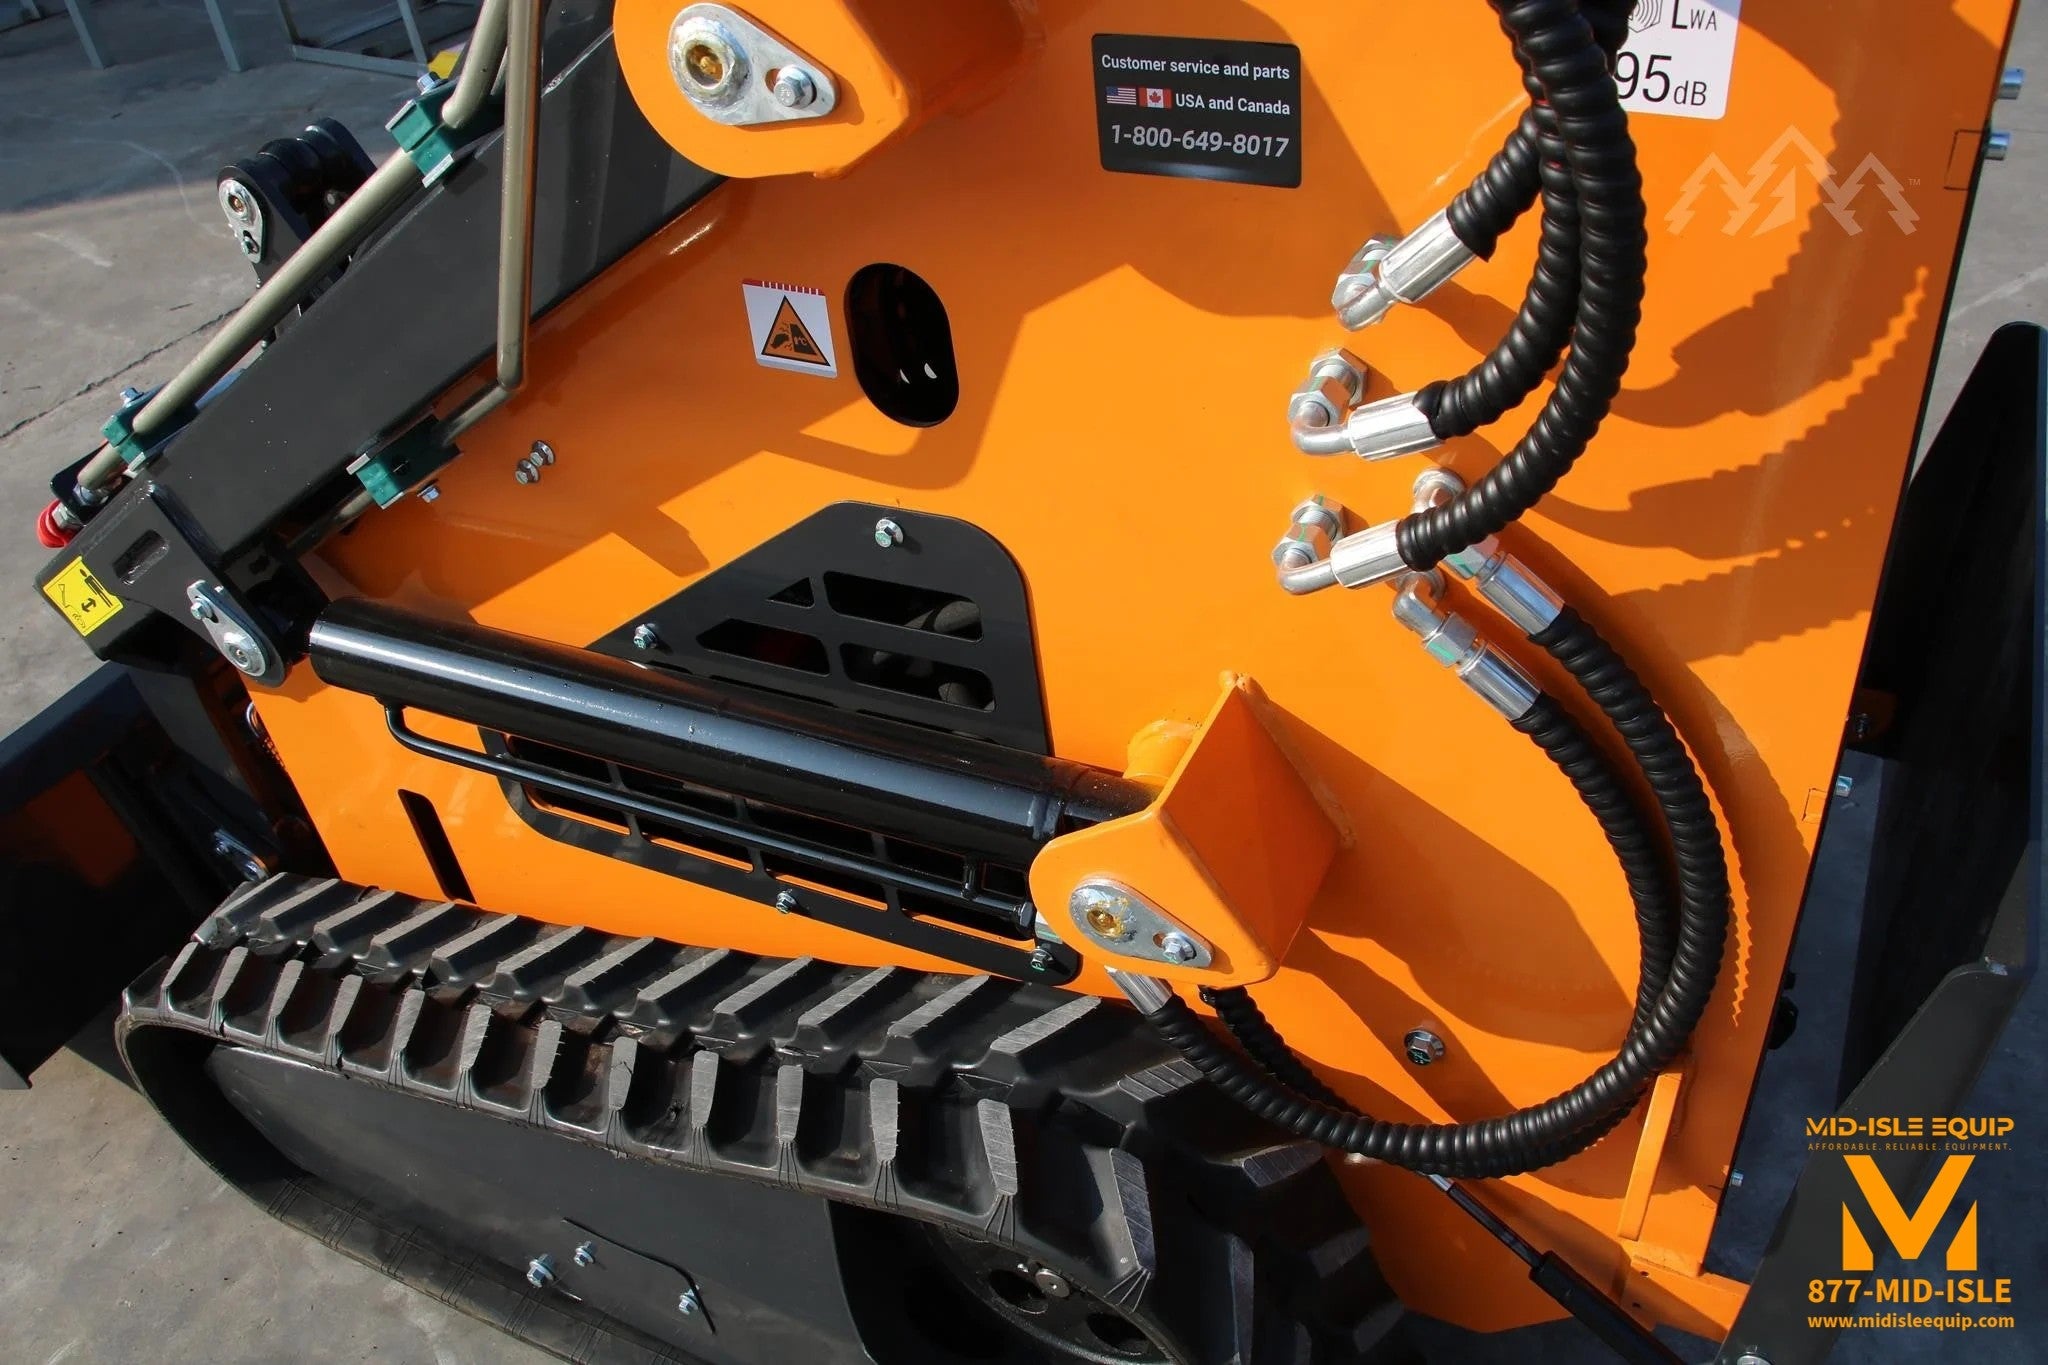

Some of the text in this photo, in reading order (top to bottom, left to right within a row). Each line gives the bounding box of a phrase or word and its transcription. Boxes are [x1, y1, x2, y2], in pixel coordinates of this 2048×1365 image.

[1101, 54, 1290, 80] Customer service and parts
[1175, 93, 1290, 115] USA and Canada
[1111, 124, 1290, 158] 1-800-649-8017
